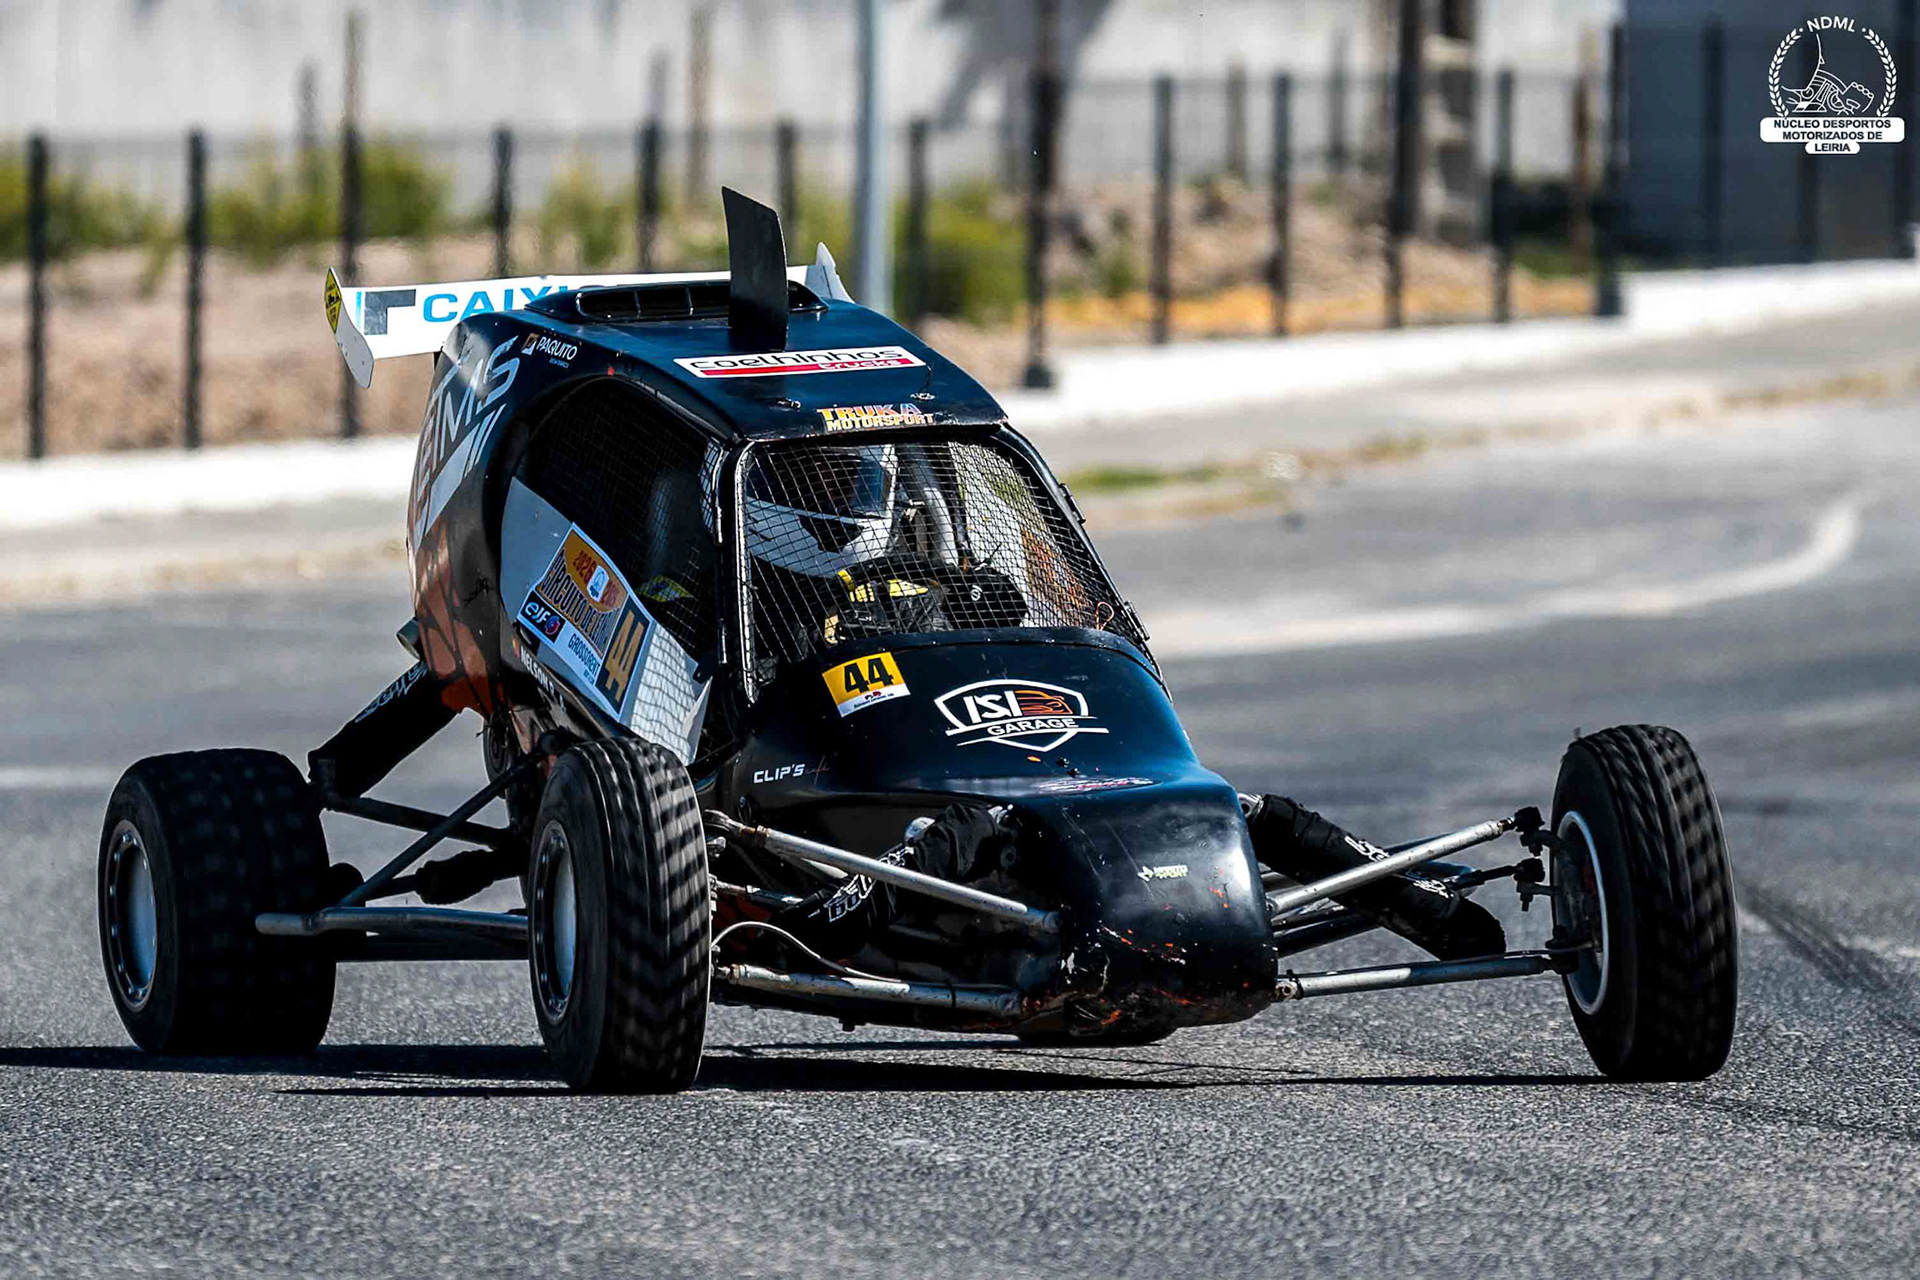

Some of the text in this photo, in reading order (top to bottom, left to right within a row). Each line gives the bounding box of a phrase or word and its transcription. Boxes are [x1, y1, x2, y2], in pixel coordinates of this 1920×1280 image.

[422, 284, 568, 323] CAIX
[535, 335, 578, 361] PAQUITO
[690, 348, 903, 370] coelhinhos
[818, 358, 901, 370] trucks
[826, 413, 935, 432] MOTORSPORT
[540, 549, 588, 623] CIRCUITO
[524, 601, 551, 623] elf
[520, 645, 550, 692] NELSON
[605, 609, 645, 703] 44
[844, 657, 894, 693] 44
[962, 690, 1024, 724] ISI
[987, 718, 1079, 736] GARAGE
[753, 763, 806, 784] CLIP'S
